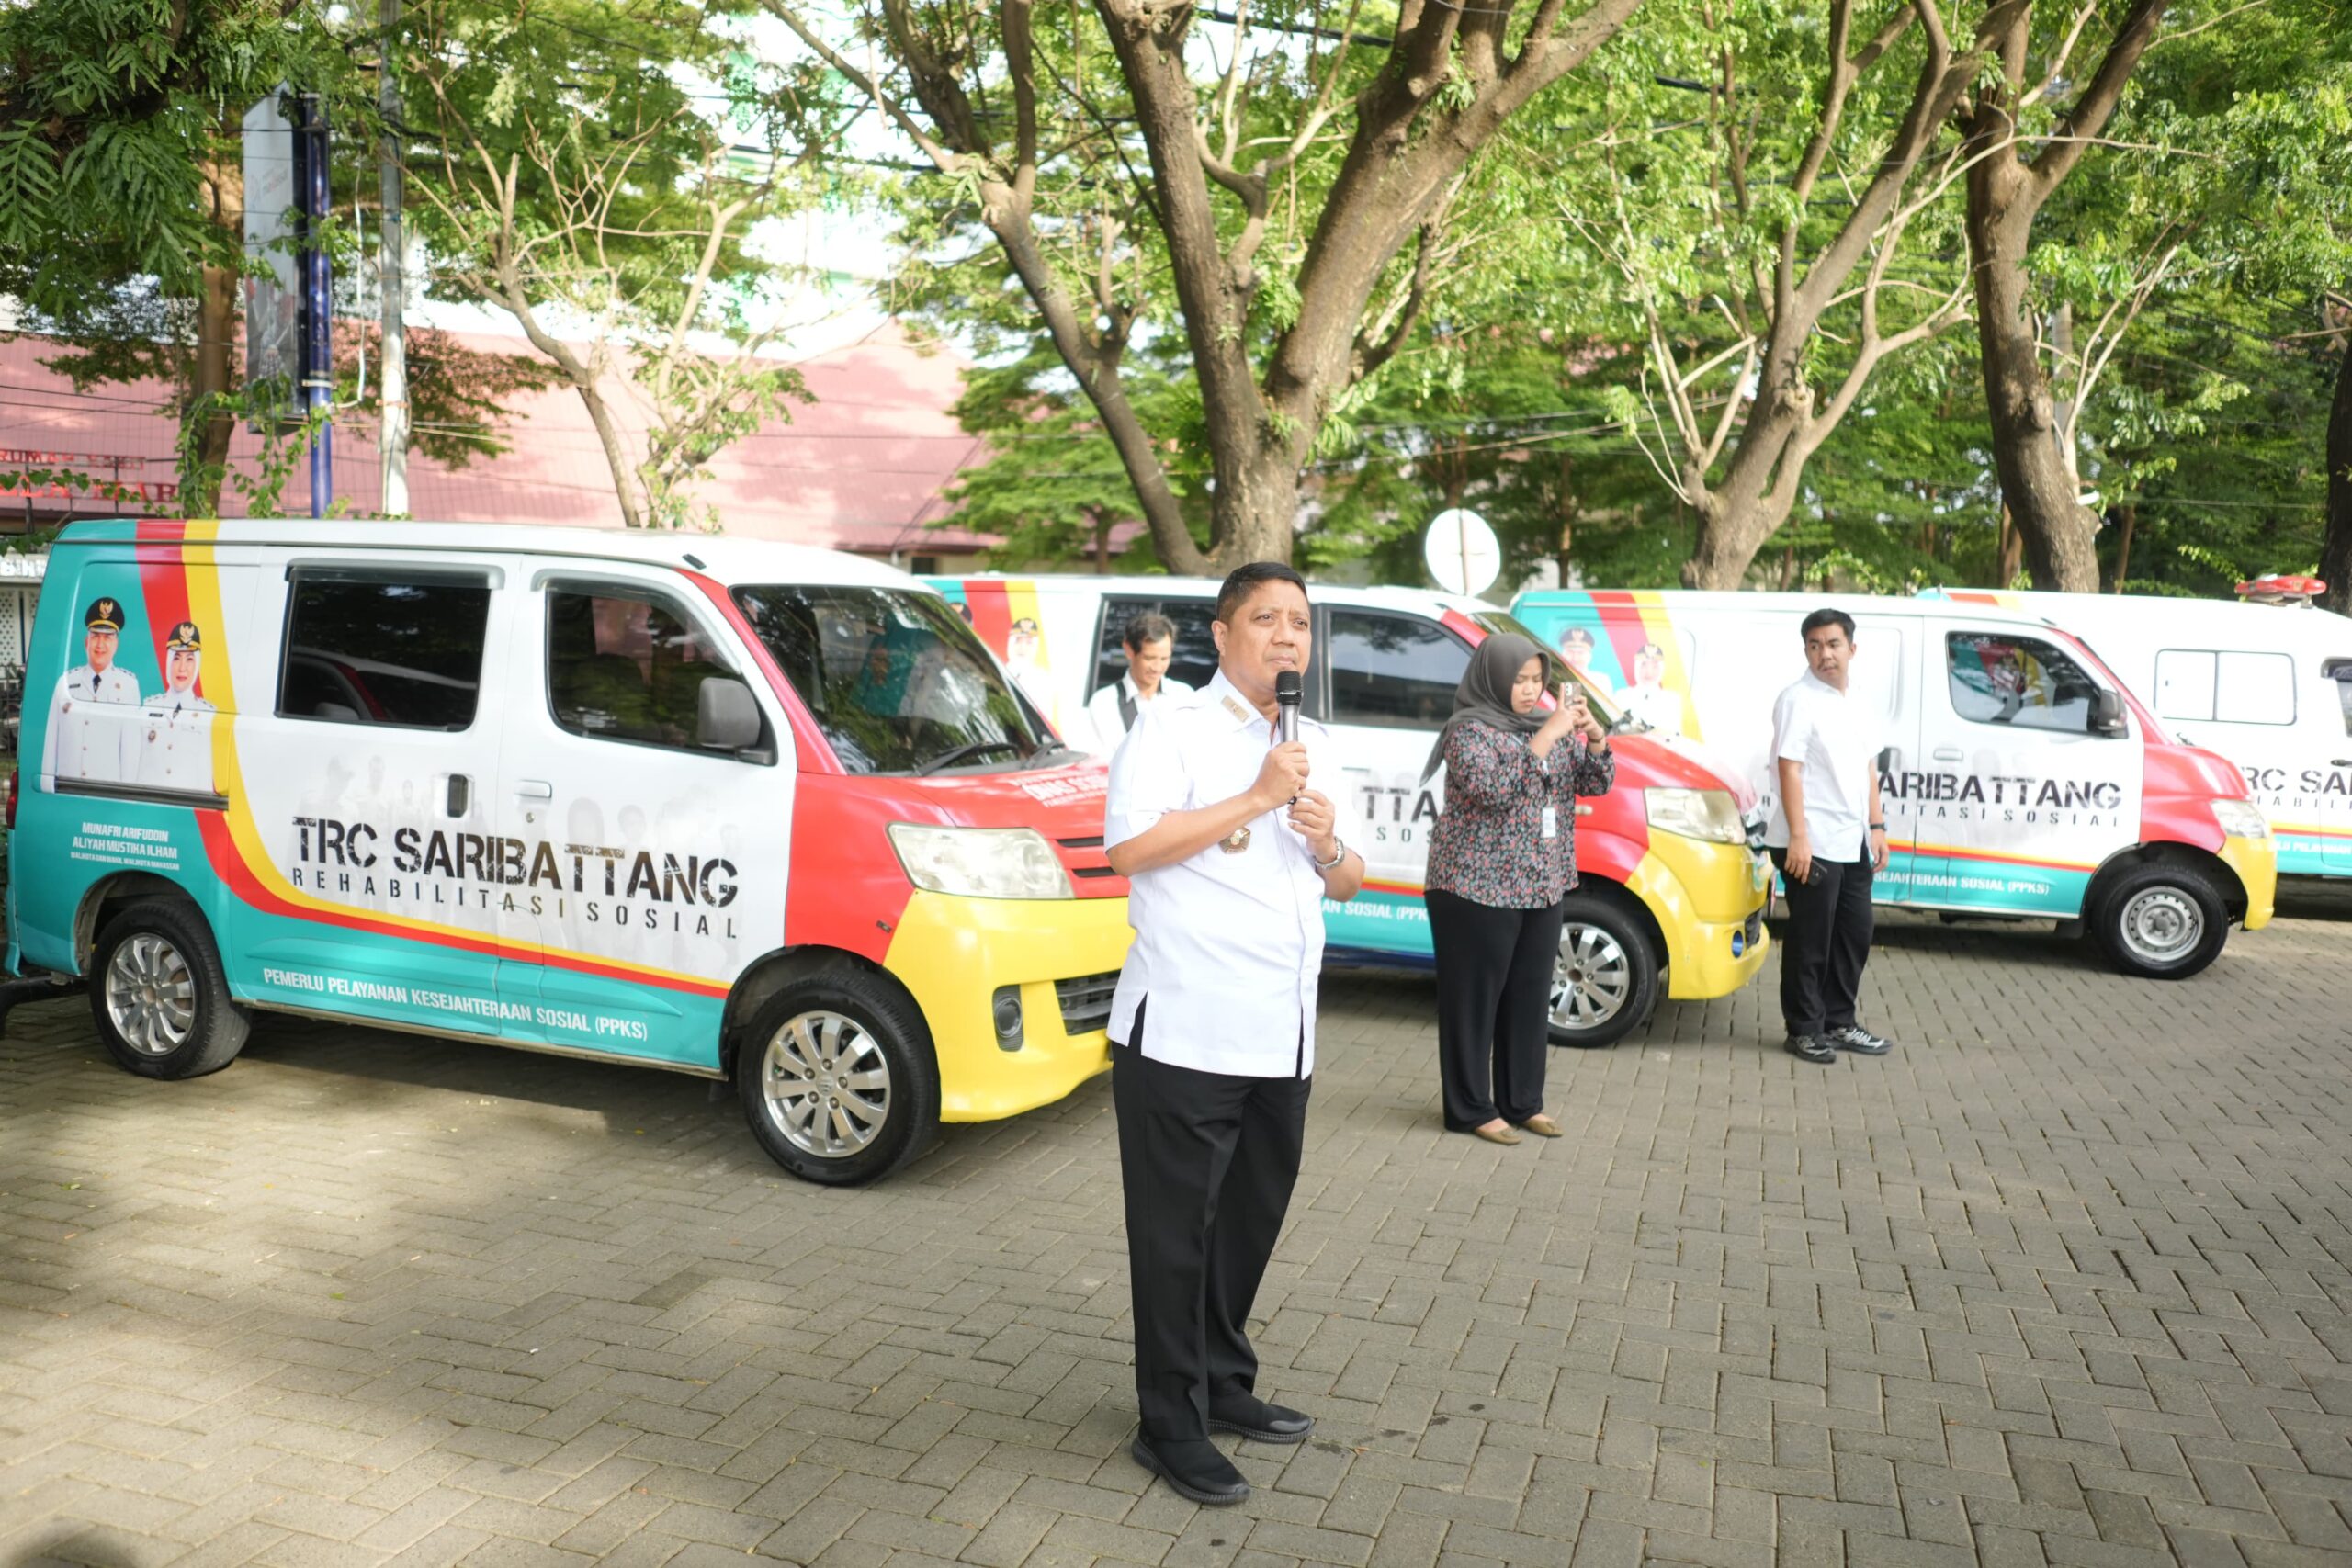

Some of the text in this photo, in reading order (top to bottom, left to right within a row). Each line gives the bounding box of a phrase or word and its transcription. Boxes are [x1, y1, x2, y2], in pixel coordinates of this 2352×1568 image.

[1878, 771, 2121, 810] ARIBATTANG
[1881, 803, 1985, 820] LITASI
[82, 822, 169, 842] MUNAFRI ARIFUDDIN
[73, 836, 105, 852] ALIYAH
[147, 844, 178, 860] ILHAM
[292, 816, 739, 908] TRC SARIBATTANG
[1872, 870, 2050, 896] SEJAHTERAAN SOSIAL (PPKS)
[292, 868, 738, 940] REHABILITASI SOSIAL
[1344, 903, 1392, 919] SOSIAL
[1396, 905, 1430, 922] (PPK
[263, 967, 648, 1043] PEMERLU PELAYANAN KESEJAHTERAAN SOSIAL (PPKS)
